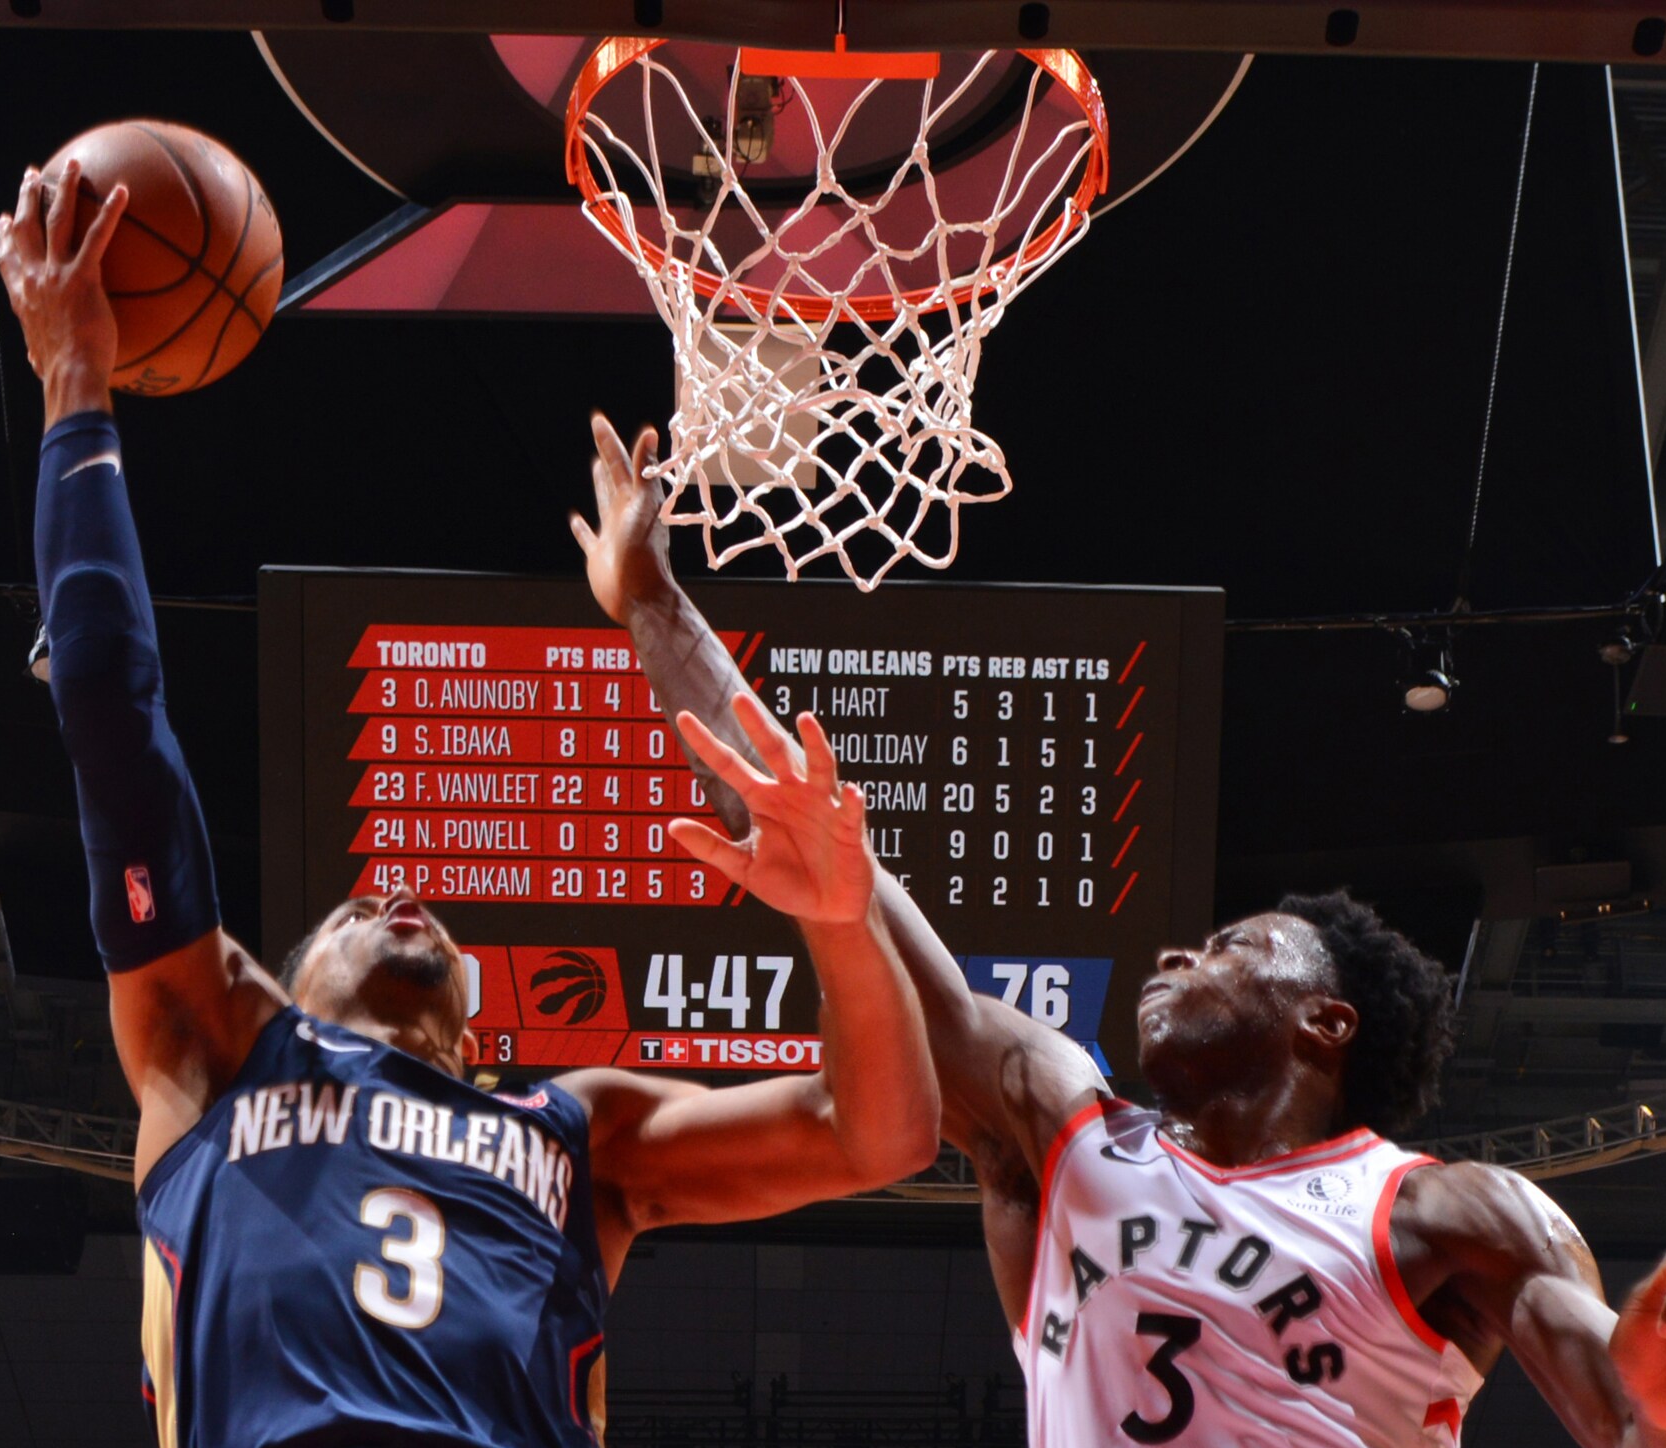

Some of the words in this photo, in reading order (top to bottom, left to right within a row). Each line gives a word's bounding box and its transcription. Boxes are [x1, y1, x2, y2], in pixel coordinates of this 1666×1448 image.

[377, 641, 486, 668] TORONTO
[546, 646, 584, 669] PTS
[592, 647, 630, 670] REB
[770, 648, 823, 674] NEW
[828, 649, 932, 677] ORLEANS
[943, 655, 981, 677] PTS
[988, 656, 1026, 679] REB
[1032, 658, 1070, 680] AST
[1075, 658, 1110, 681] FLS
[381, 678, 396, 708] 3
[415, 678, 434, 709] O.
[441, 679, 539, 710] ANUNOBY
[553, 681, 583, 711] 11
[604, 683, 621, 712] 4
[775, 686, 791, 715] 3
[811, 687, 824, 716] J.
[832, 687, 889, 717] HART
[954, 690, 969, 719] 5
[997, 691, 1013, 720] 3
[1043, 692, 1056, 721] 1
[1085, 693, 1098, 722] 1
[381, 724, 397, 754] 9
[415, 725, 434, 755] S.
[441, 726, 511, 756] IBAKA
[560, 728, 575, 757] 8
[604, 729, 621, 758] 4
[649, 730, 664, 759] 0
[832, 734, 928, 764] HOLIDAY
[952, 736, 968, 766] 6
[997, 738, 1011, 767] 1
[1041, 739, 1056, 768] 5
[1083, 739, 1097, 768] 1
[374, 772, 405, 801] 23
[415, 772, 432, 802] F.
[438, 773, 539, 803] VANVLEET
[552, 775, 583, 805] 22
[604, 776, 620, 805] 4
[649, 777, 663, 806] 5
[691, 778, 705, 807] 0
[842, 781, 926, 811] GRAM
[943, 783, 975, 813] 20
[995, 784, 1010, 813] 5
[1039, 785, 1054, 815] 2
[1081, 786, 1097, 815] 3
[374, 819, 405, 848] 24
[416, 819, 436, 849] N.
[444, 820, 531, 850] POWELL
[559, 822, 575, 851] 0
[604, 823, 619, 852] 3
[648, 824, 663, 853] 0
[868, 828, 902, 858] LLI
[950, 829, 965, 859] 9
[994, 831, 1009, 860] 0
[1037, 832, 1053, 861] 0
[1080, 833, 1093, 862] 1
[374, 865, 405, 893] 43
[416, 865, 435, 896] P.
[442, 866, 530, 896] SIAKAM
[551, 868, 583, 898] 20
[596, 868, 626, 898] 12
[648, 870, 662, 899] 5
[689, 871, 704, 899] 3
[949, 876, 964, 905] 2
[993, 876, 1008, 906] 2
[1037, 878, 1050, 906] 1
[1078, 878, 1093, 907] 0
[643, 953, 794, 1030] 4:47
[992, 963, 1070, 1030] 76
[498, 1035, 512, 1063] 3
[693, 1038, 823, 1065] TISSOT
[228, 1085, 357, 1163] NEW
[368, 1092, 573, 1234] ORLEANS
[353, 1187, 445, 1330] 3
[1040, 1215, 1346, 1388] RAPTORS
[1119, 1312, 1202, 1446] 3
